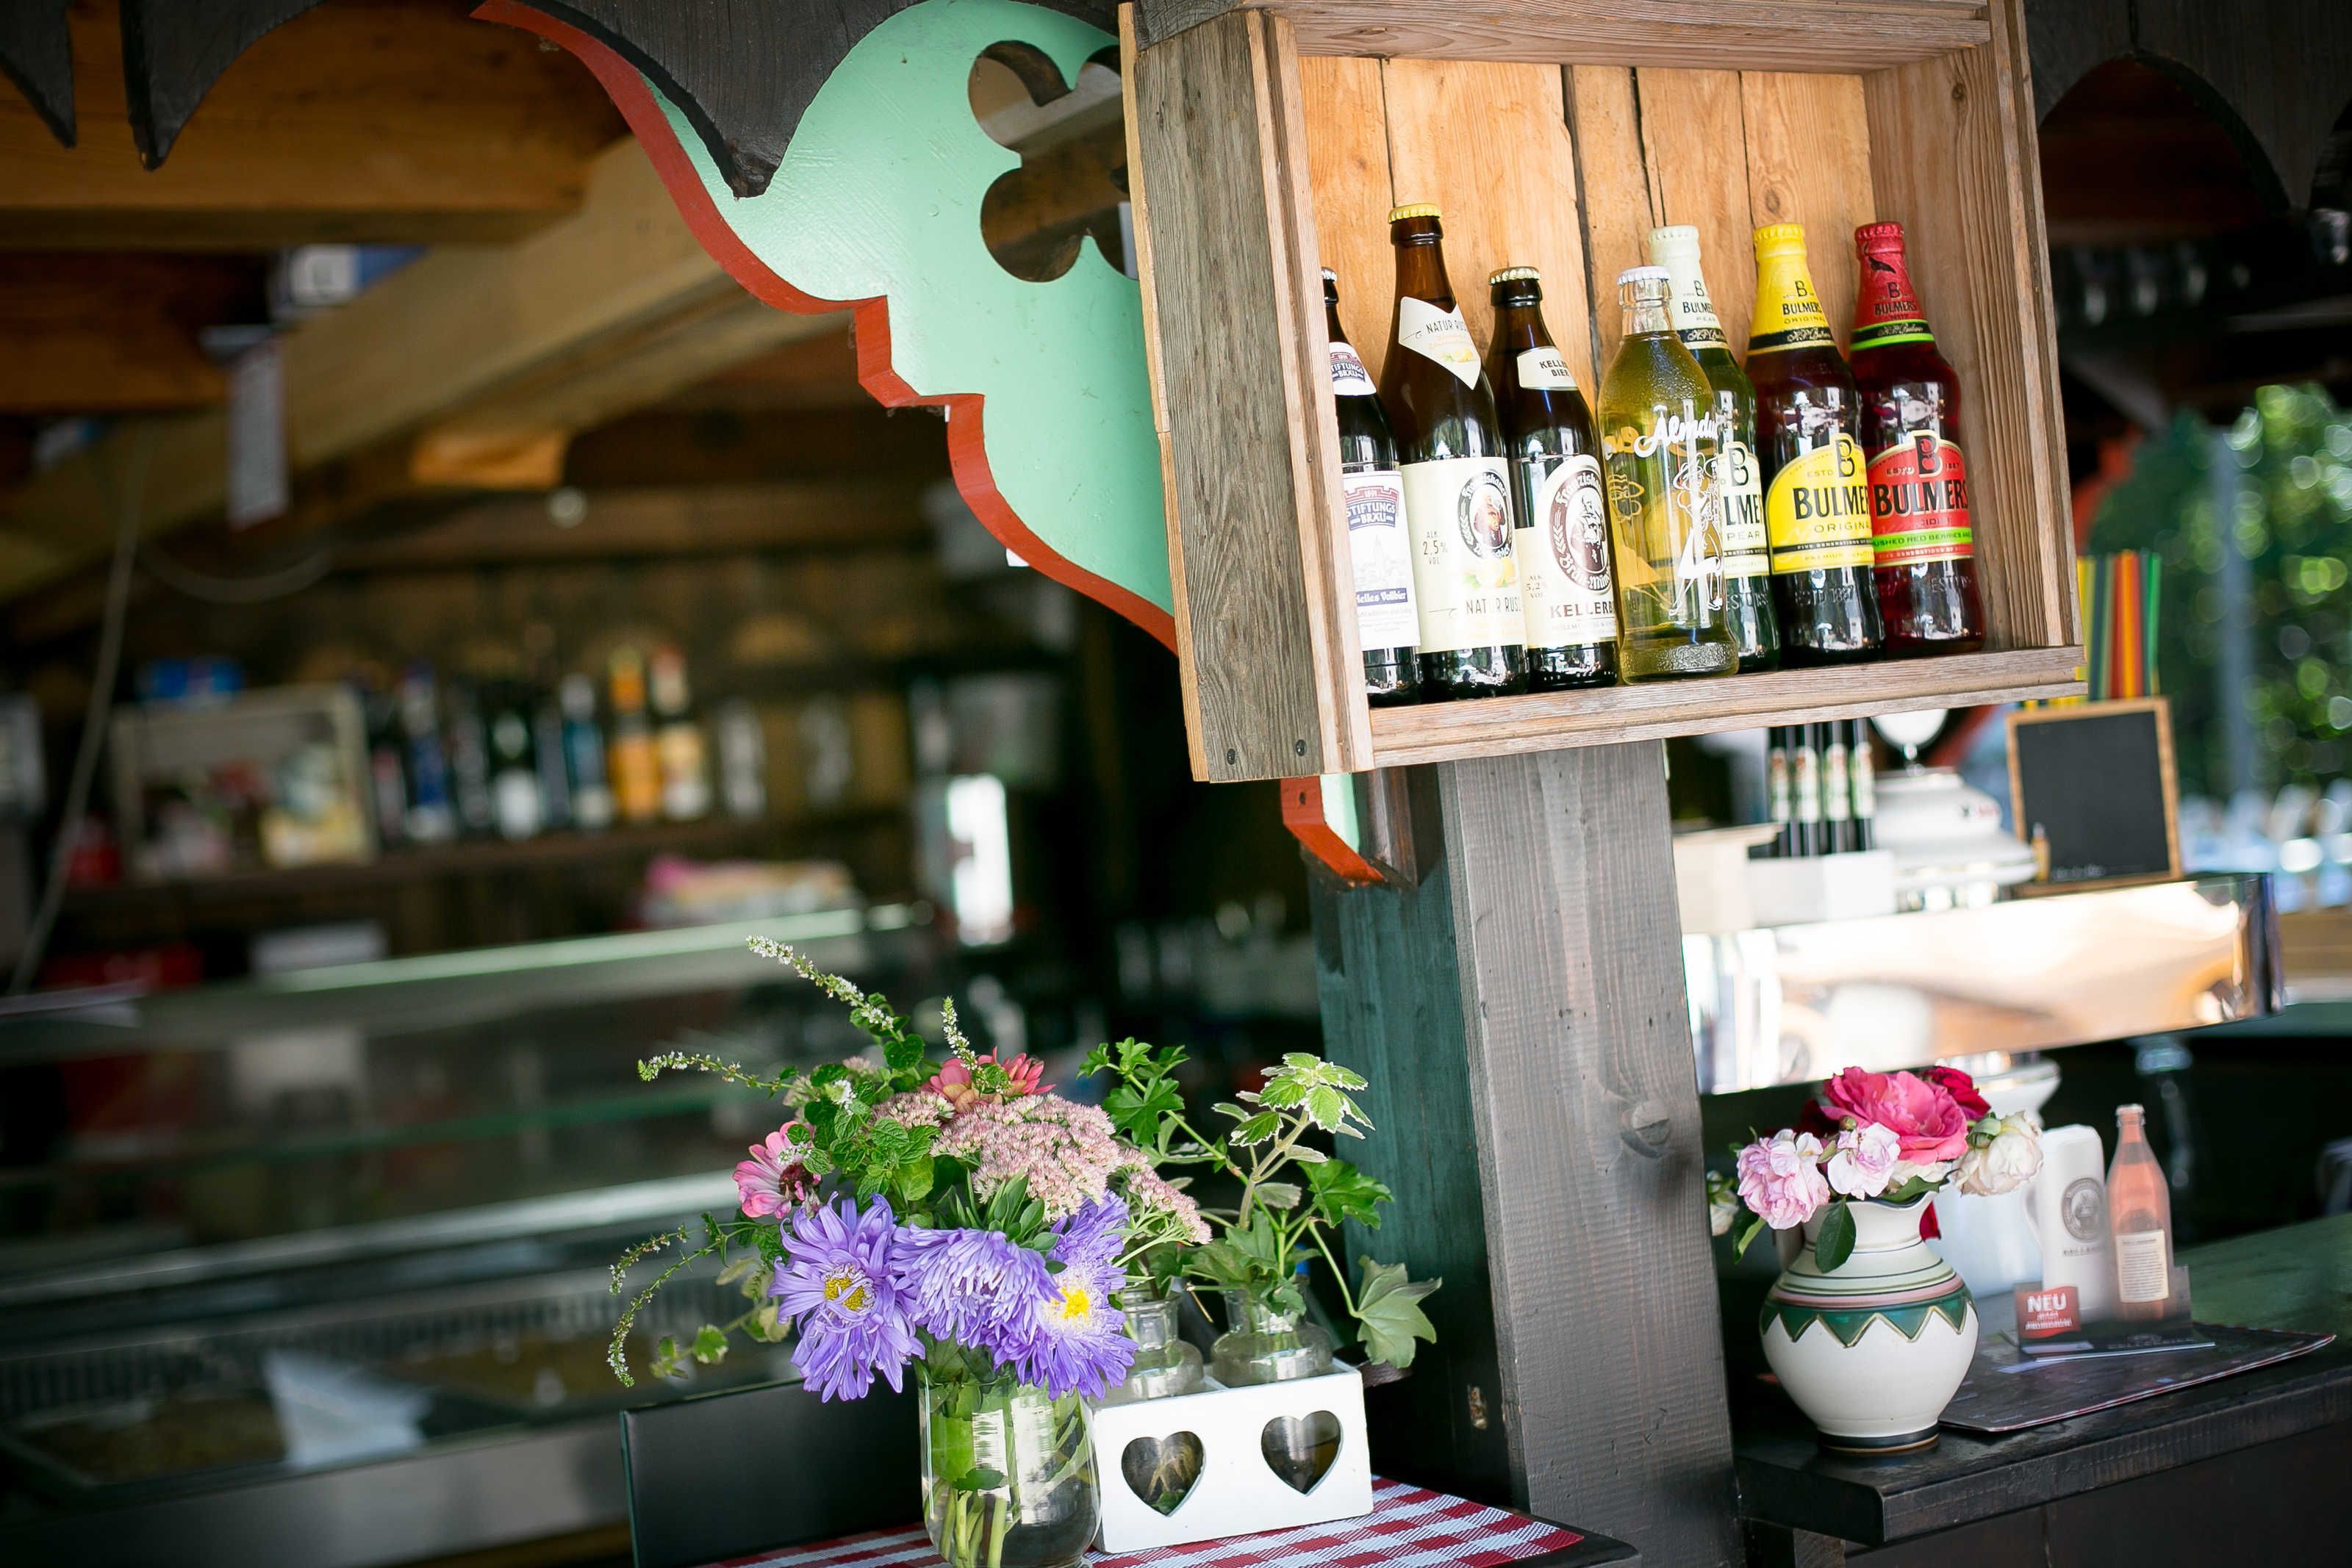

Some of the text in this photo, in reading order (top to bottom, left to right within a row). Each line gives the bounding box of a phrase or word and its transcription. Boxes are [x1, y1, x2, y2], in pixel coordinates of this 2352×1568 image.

[1874, 301, 1917, 316] BULMERS
[1425, 320, 1452, 334] NATUR
[1874, 479, 1968, 517] BULMERS
[2027, 1292, 2067, 1313] NEU
